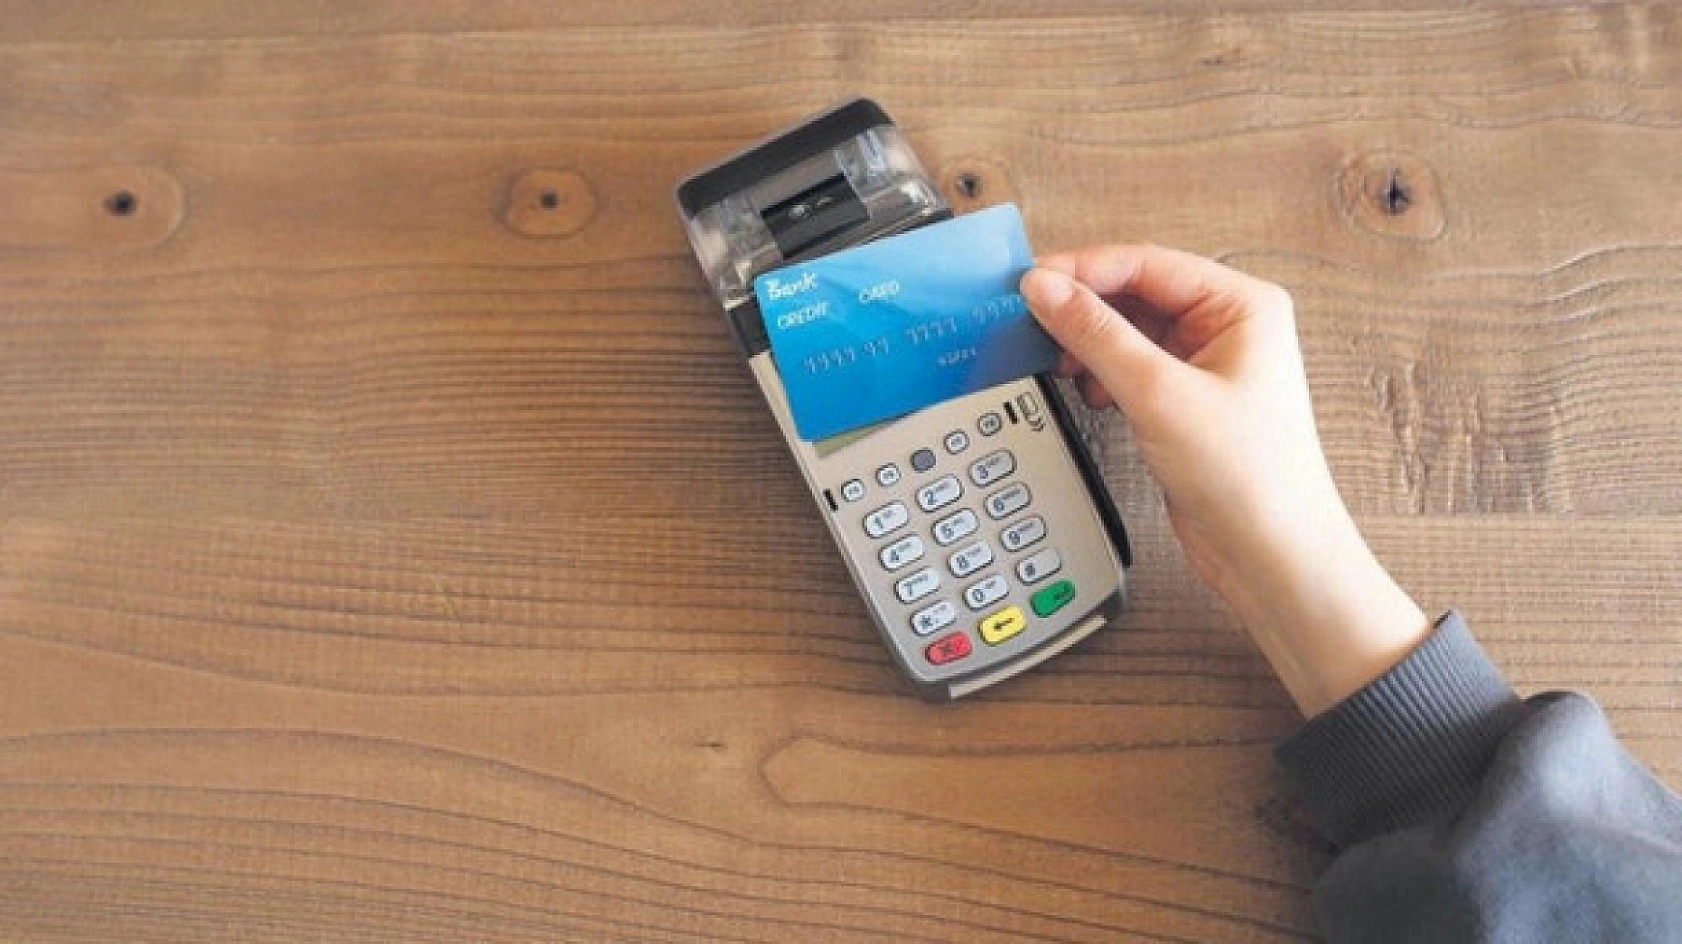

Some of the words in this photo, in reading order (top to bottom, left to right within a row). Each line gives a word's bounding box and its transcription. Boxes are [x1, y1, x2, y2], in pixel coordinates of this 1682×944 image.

[765, 273, 818, 300] Bank
[777, 302, 828, 329] CREDIT
[859, 279, 900, 305] CARD
[976, 464, 989, 480] 3
[924, 488, 937, 505] 2
[993, 496, 1005, 512] 6
[940, 522, 954, 539] 5
[1008, 530, 1021, 545] 9
[889, 548, 900, 564] 4
[956, 553, 970, 569] 8
[903, 580, 914, 597] 7
